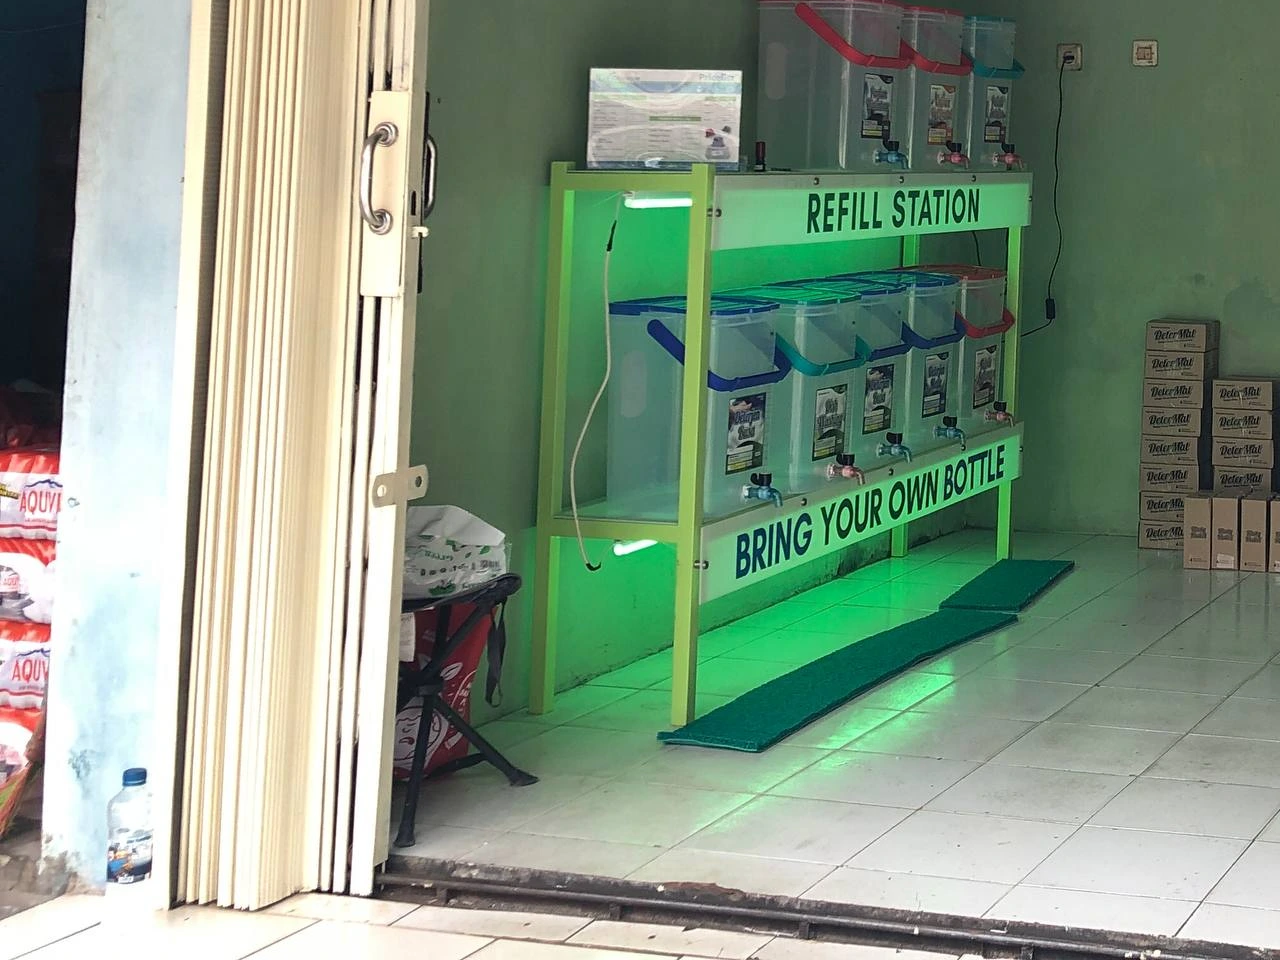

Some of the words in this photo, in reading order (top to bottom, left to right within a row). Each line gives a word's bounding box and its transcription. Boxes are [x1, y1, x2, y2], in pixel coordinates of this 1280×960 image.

[807, 191, 883, 234] REFILL
[892, 189, 980, 228] STATION
[735, 512, 813, 579] BRING
[821, 486, 882, 542] YOUR
[887, 472, 938, 520] OWN
[942, 444, 1005, 501] BOTTLE
